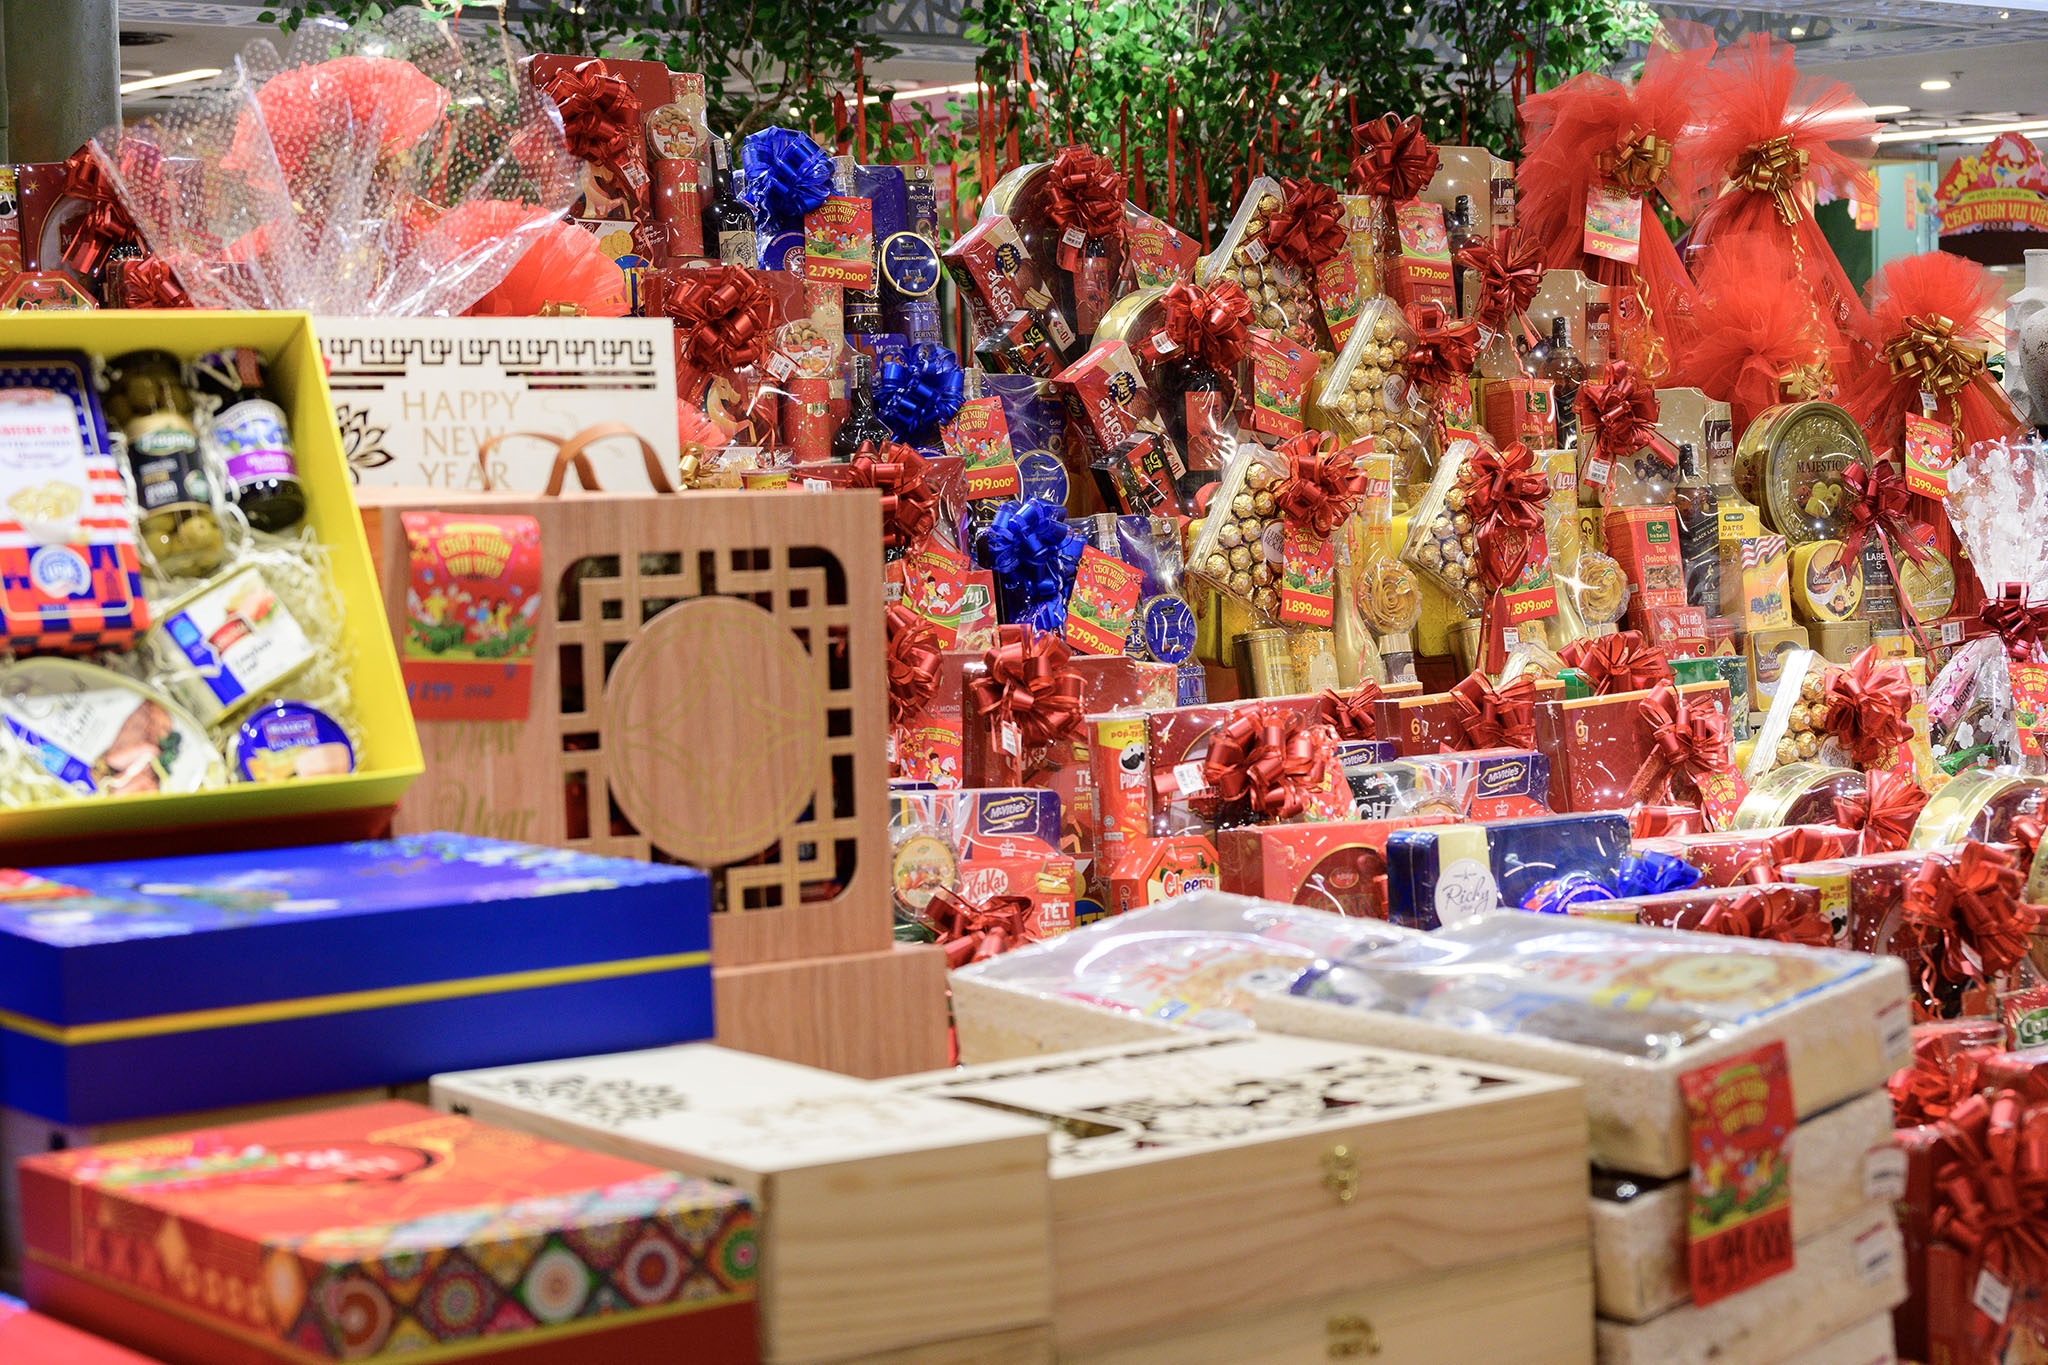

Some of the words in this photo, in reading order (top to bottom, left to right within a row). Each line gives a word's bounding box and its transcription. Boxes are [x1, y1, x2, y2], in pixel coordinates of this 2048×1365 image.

[402, 391, 521, 421] HAPPY
[423, 427, 506, 456] NEW
[419, 462, 511, 489] YEAR
[1795, 459, 1842, 474] MAJESTIC
[1722, 524, 1743, 532] DATES
[1644, 554, 1668, 564] Oolong
[1655, 545, 1667, 554] Tea
[1865, 552, 1887, 561] LABE
[1410, 717, 1420, 736] 6
[1575, 718, 1586, 738] 6
[966, 868, 1007, 901] KitKat
